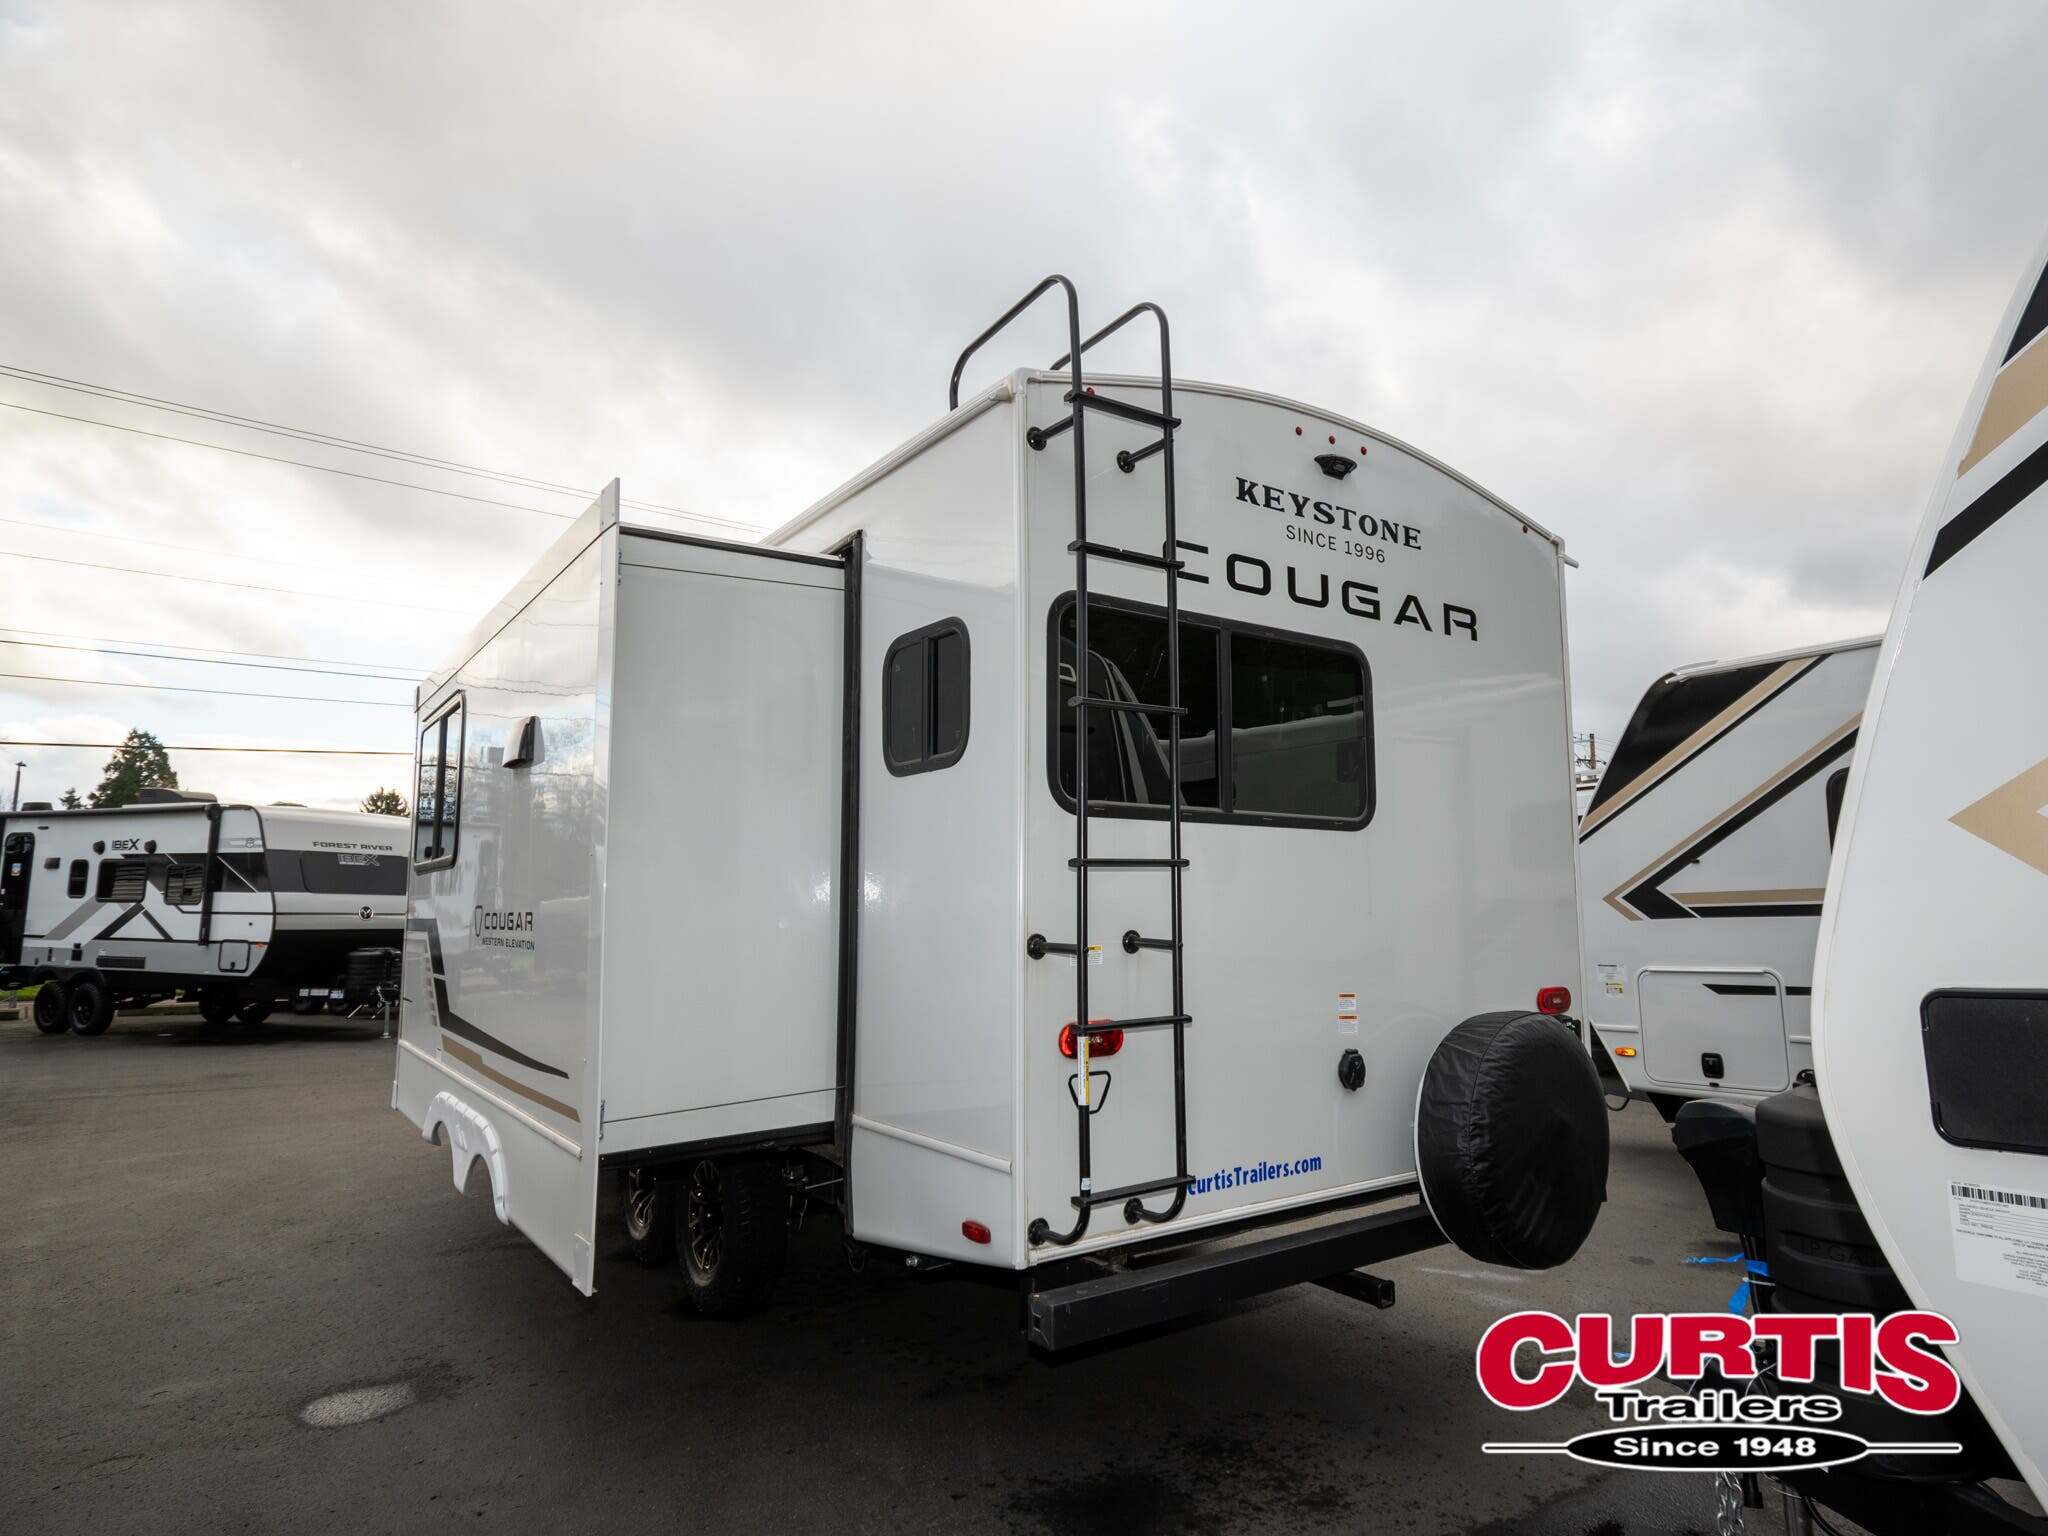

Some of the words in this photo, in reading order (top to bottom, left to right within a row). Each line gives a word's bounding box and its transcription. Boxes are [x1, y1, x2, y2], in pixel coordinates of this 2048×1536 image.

[1235, 476, 1422, 551] KEYSTONE
[1286, 524, 1338, 551] SINCE
[1344, 540, 1386, 564] 1996
[312, 841, 358, 849] FOREST
[484, 911, 533, 931] COUGAR
[505, 938, 535, 951] ELEVATION
